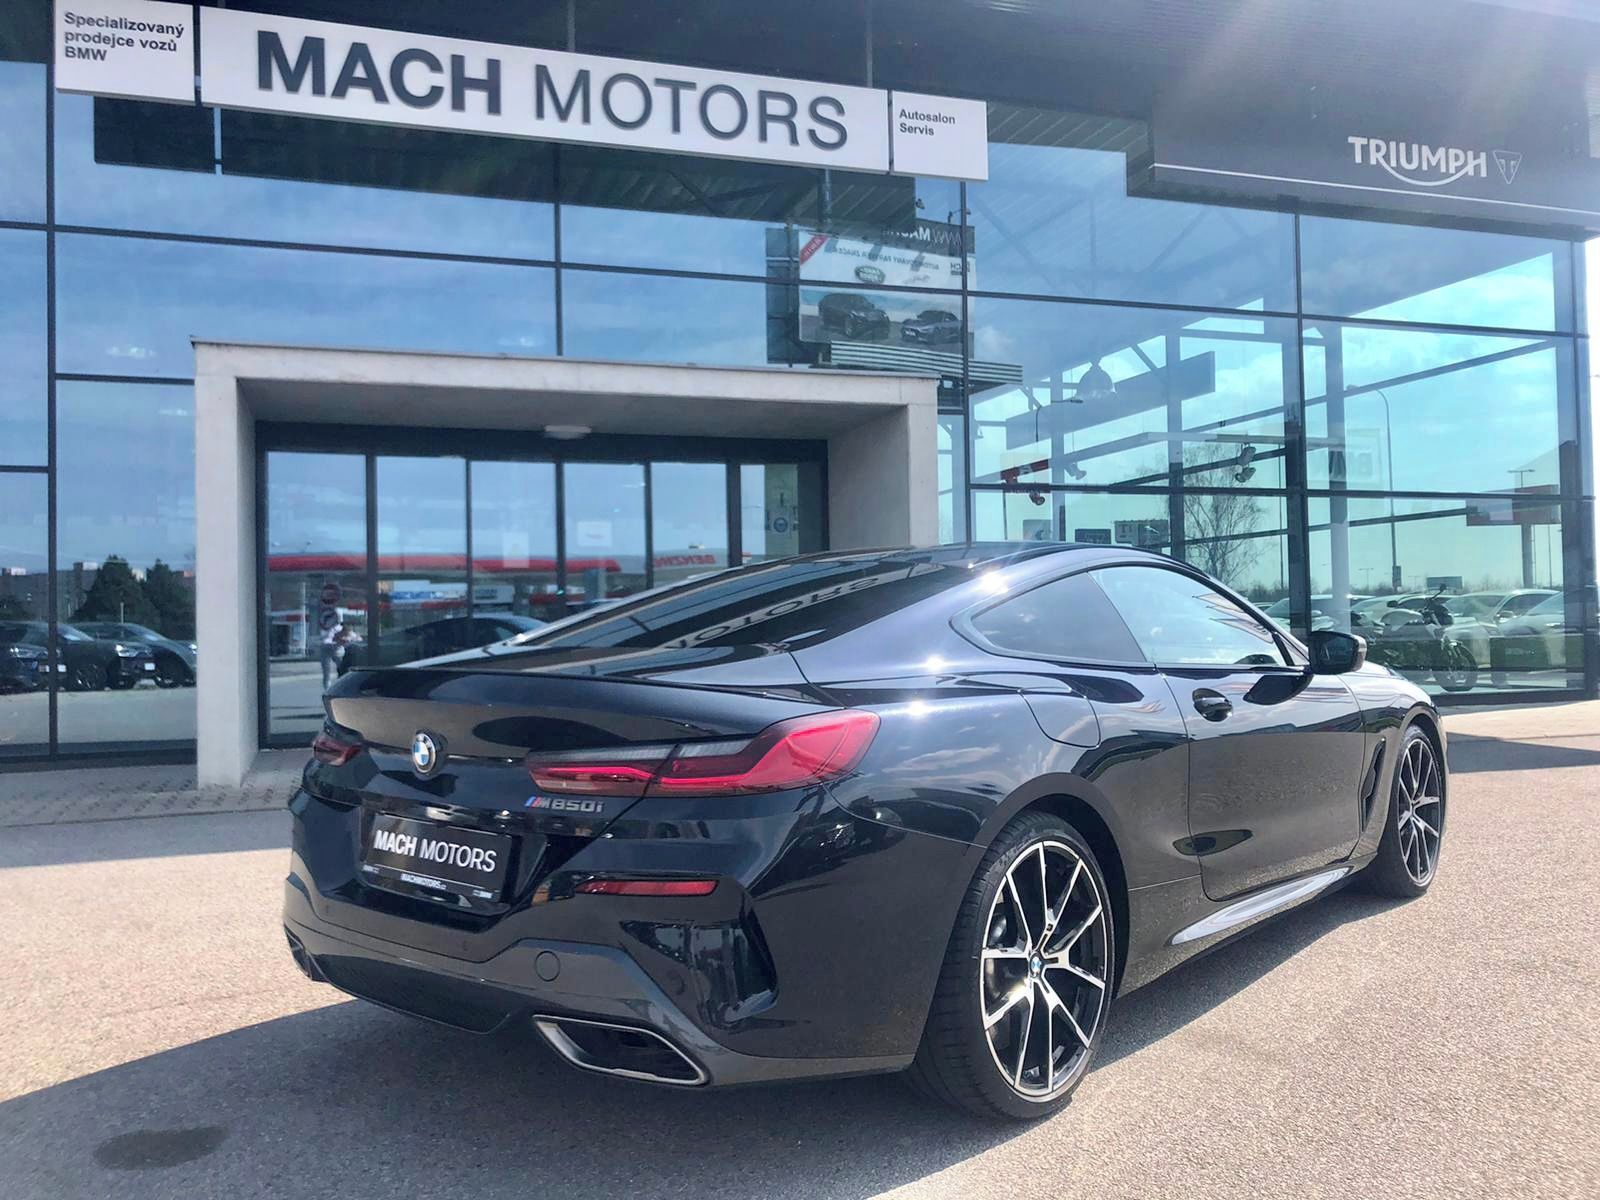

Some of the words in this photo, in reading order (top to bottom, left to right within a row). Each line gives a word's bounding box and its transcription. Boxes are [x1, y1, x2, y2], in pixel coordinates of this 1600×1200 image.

[64, 11, 184, 38] Specializovaný
[65, 31, 134, 48] prodejce
[139, 39, 177, 51] vozů
[65, 46, 107, 61] BMW
[257, 30, 501, 116] MACH
[534, 64, 848, 151] MOTORS
[899, 109, 956, 124] Autosalon
[899, 122, 934, 136] Servis
[1348, 136, 1487, 186] TRIUMPH
[525, 796, 604, 813] M850i
[374, 830, 418, 857] MACH
[420, 838, 497, 872] MOTORS
